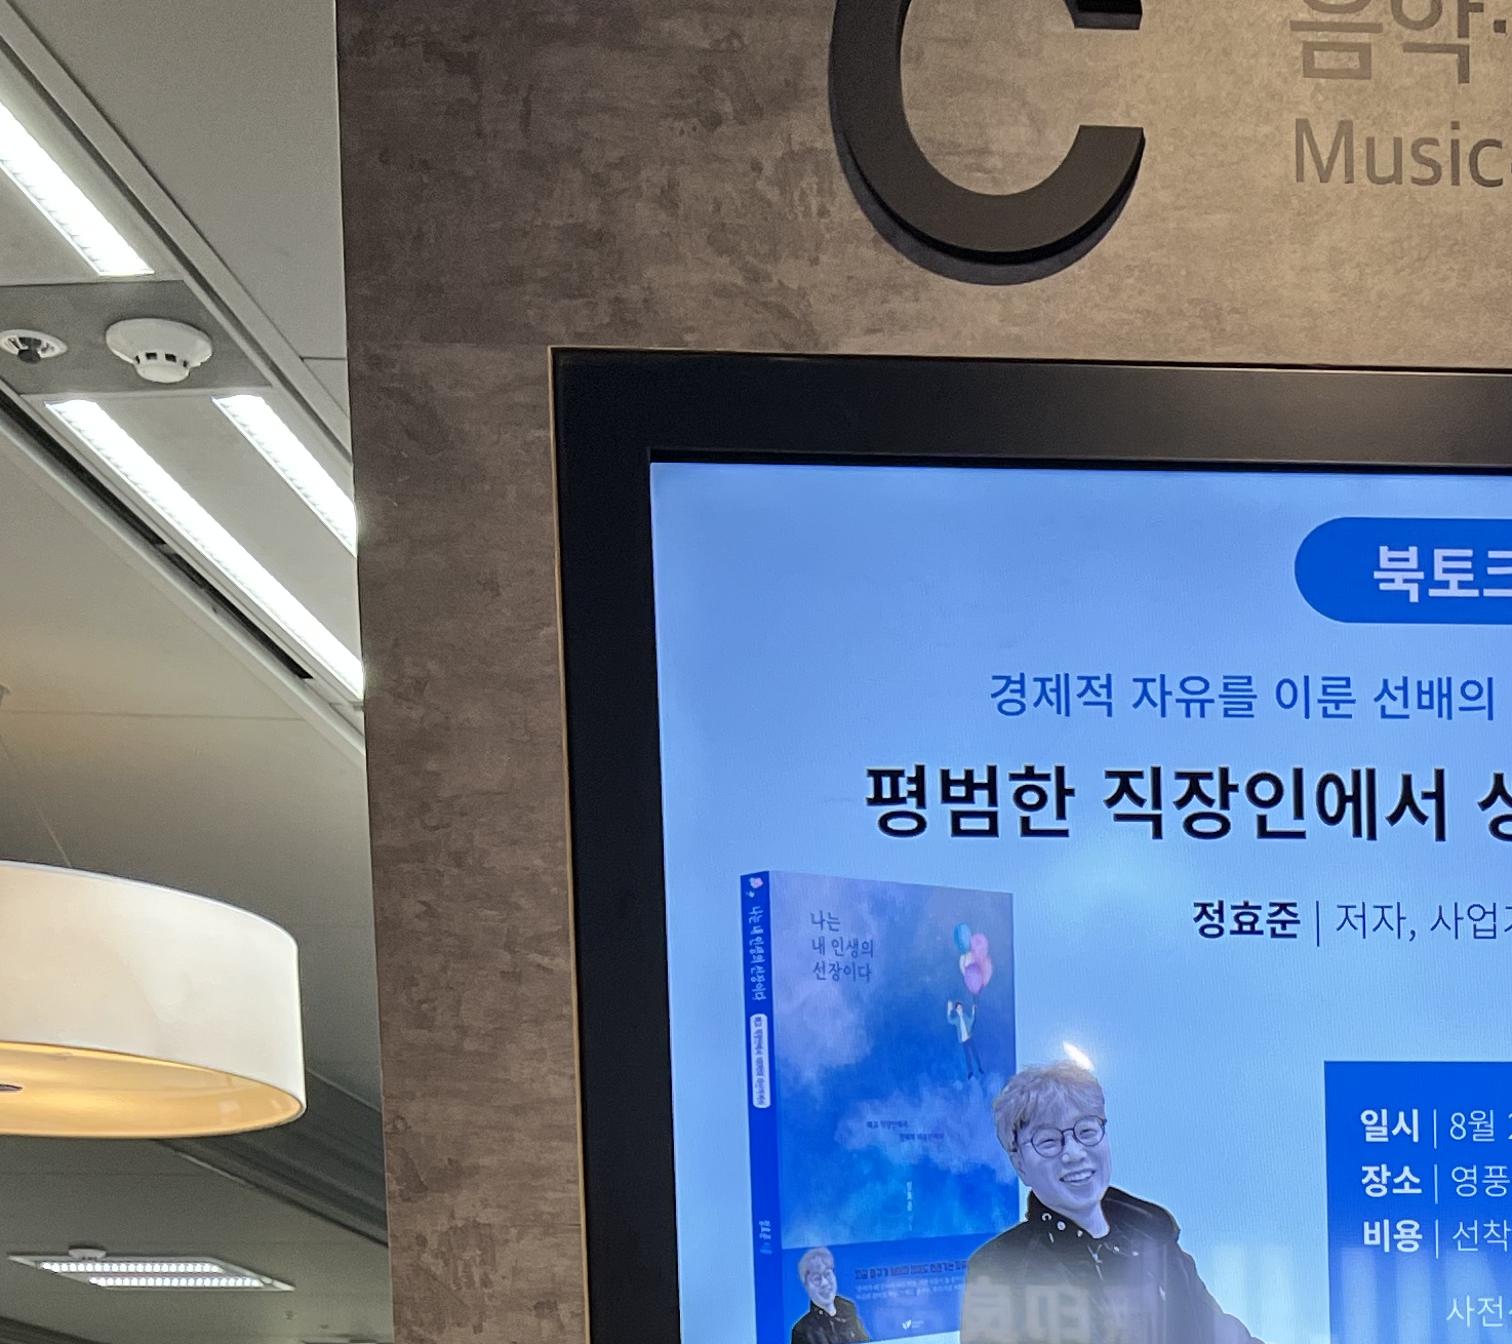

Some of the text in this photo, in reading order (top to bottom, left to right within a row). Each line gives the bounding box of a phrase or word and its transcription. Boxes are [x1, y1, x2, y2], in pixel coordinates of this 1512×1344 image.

[828, 0, 1144, 263] C
[991, 673, 1112, 717] 경제적
[1133, 674, 1257, 718] 자유를
[1276, 675, 1356, 719] 이룬
[1374, 676, 1493, 720] 선배의
[866, 765, 1075, 837] 평범한
[1104, 767, 1445, 841] 직장인에서
[811, 910, 840, 932] 나는
[1194, 900, 1300, 938] 정효준
[1337, 902, 1415, 941] 저자,
[812, 936, 873, 958] 내 인생의
[813, 961, 872, 983] 선장이다
[1361, 1109, 1418, 1142] 일시
[1450, 1110, 1494, 1141] 8월
[1362, 1164, 1422, 1197] 장소
[1364, 1220, 1422, 1252] 비용
